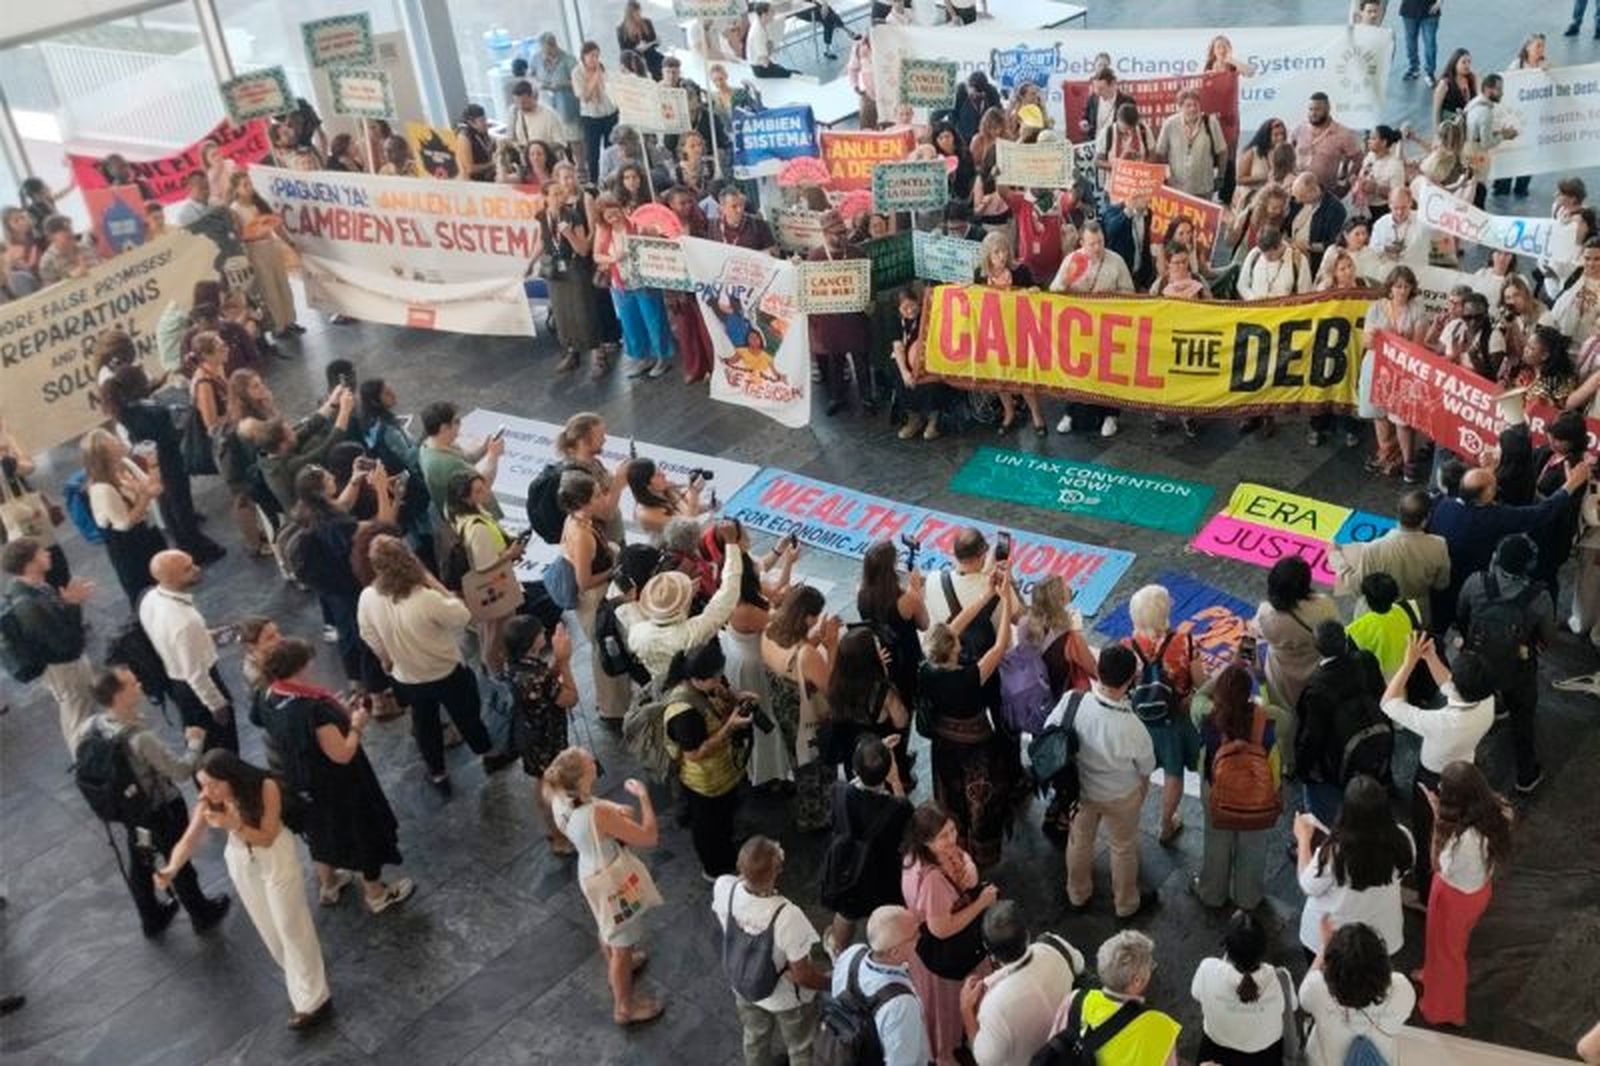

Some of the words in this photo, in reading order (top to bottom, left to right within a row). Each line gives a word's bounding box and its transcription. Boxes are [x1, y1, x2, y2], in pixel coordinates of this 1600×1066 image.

[1056, 57, 1096, 74] Deb
[1116, 54, 1198, 79] Change
[1247, 55, 1326, 76] System
[733, 115, 802, 134] CAMBIEN
[831, 138, 901, 159] ANULEN
[1152, 195, 1206, 226] NULEN
[396, 216, 432, 248] EL
[811, 275, 853, 287] CANCEL
[41, 289, 88, 318] FALSE
[2, 277, 161, 369] REPARATIONS
[940, 286, 1164, 389] CANCEL
[1171, 336, 1221, 367] THE
[1229, 316, 1364, 392] DEB
[1383, 343, 1434, 381] MAKE
[1434, 369, 1492, 411] TAXES
[995, 454, 1022, 467] UN
[1026, 459, 1061, 474] TAX
[1064, 466, 1191, 497] CONVENTION
[1058, 476, 1111, 492] NOW!
[760, 479, 910, 540] WEALTH
[1245, 495, 1317, 531] ERA
[736, 510, 765, 525] FOR
[767, 515, 852, 549] ECONOMIC
